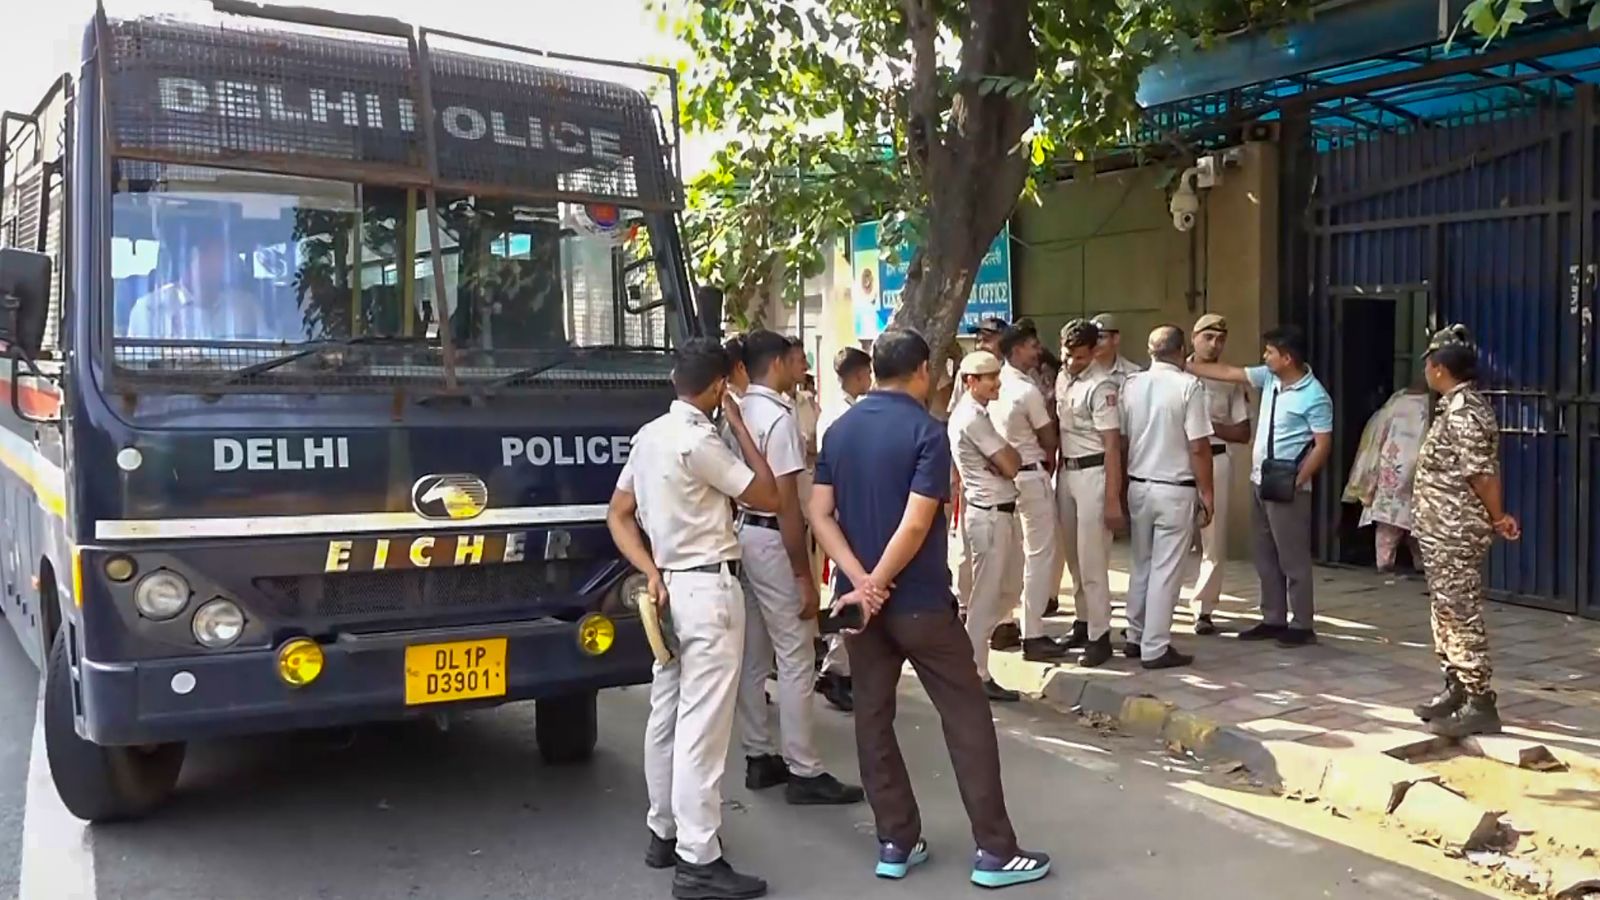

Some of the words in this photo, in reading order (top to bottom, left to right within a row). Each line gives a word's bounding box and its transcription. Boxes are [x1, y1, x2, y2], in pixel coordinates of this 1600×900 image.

[158, 76, 384, 129] DELHI
[979, 282, 1008, 304] OFFICE
[213, 437, 350, 471] DELHI
[501, 436, 631, 467] POLICE
[324, 530, 573, 573] EICHER
[435, 646, 487, 671] DL1P
[427, 668, 490, 695] D3901
